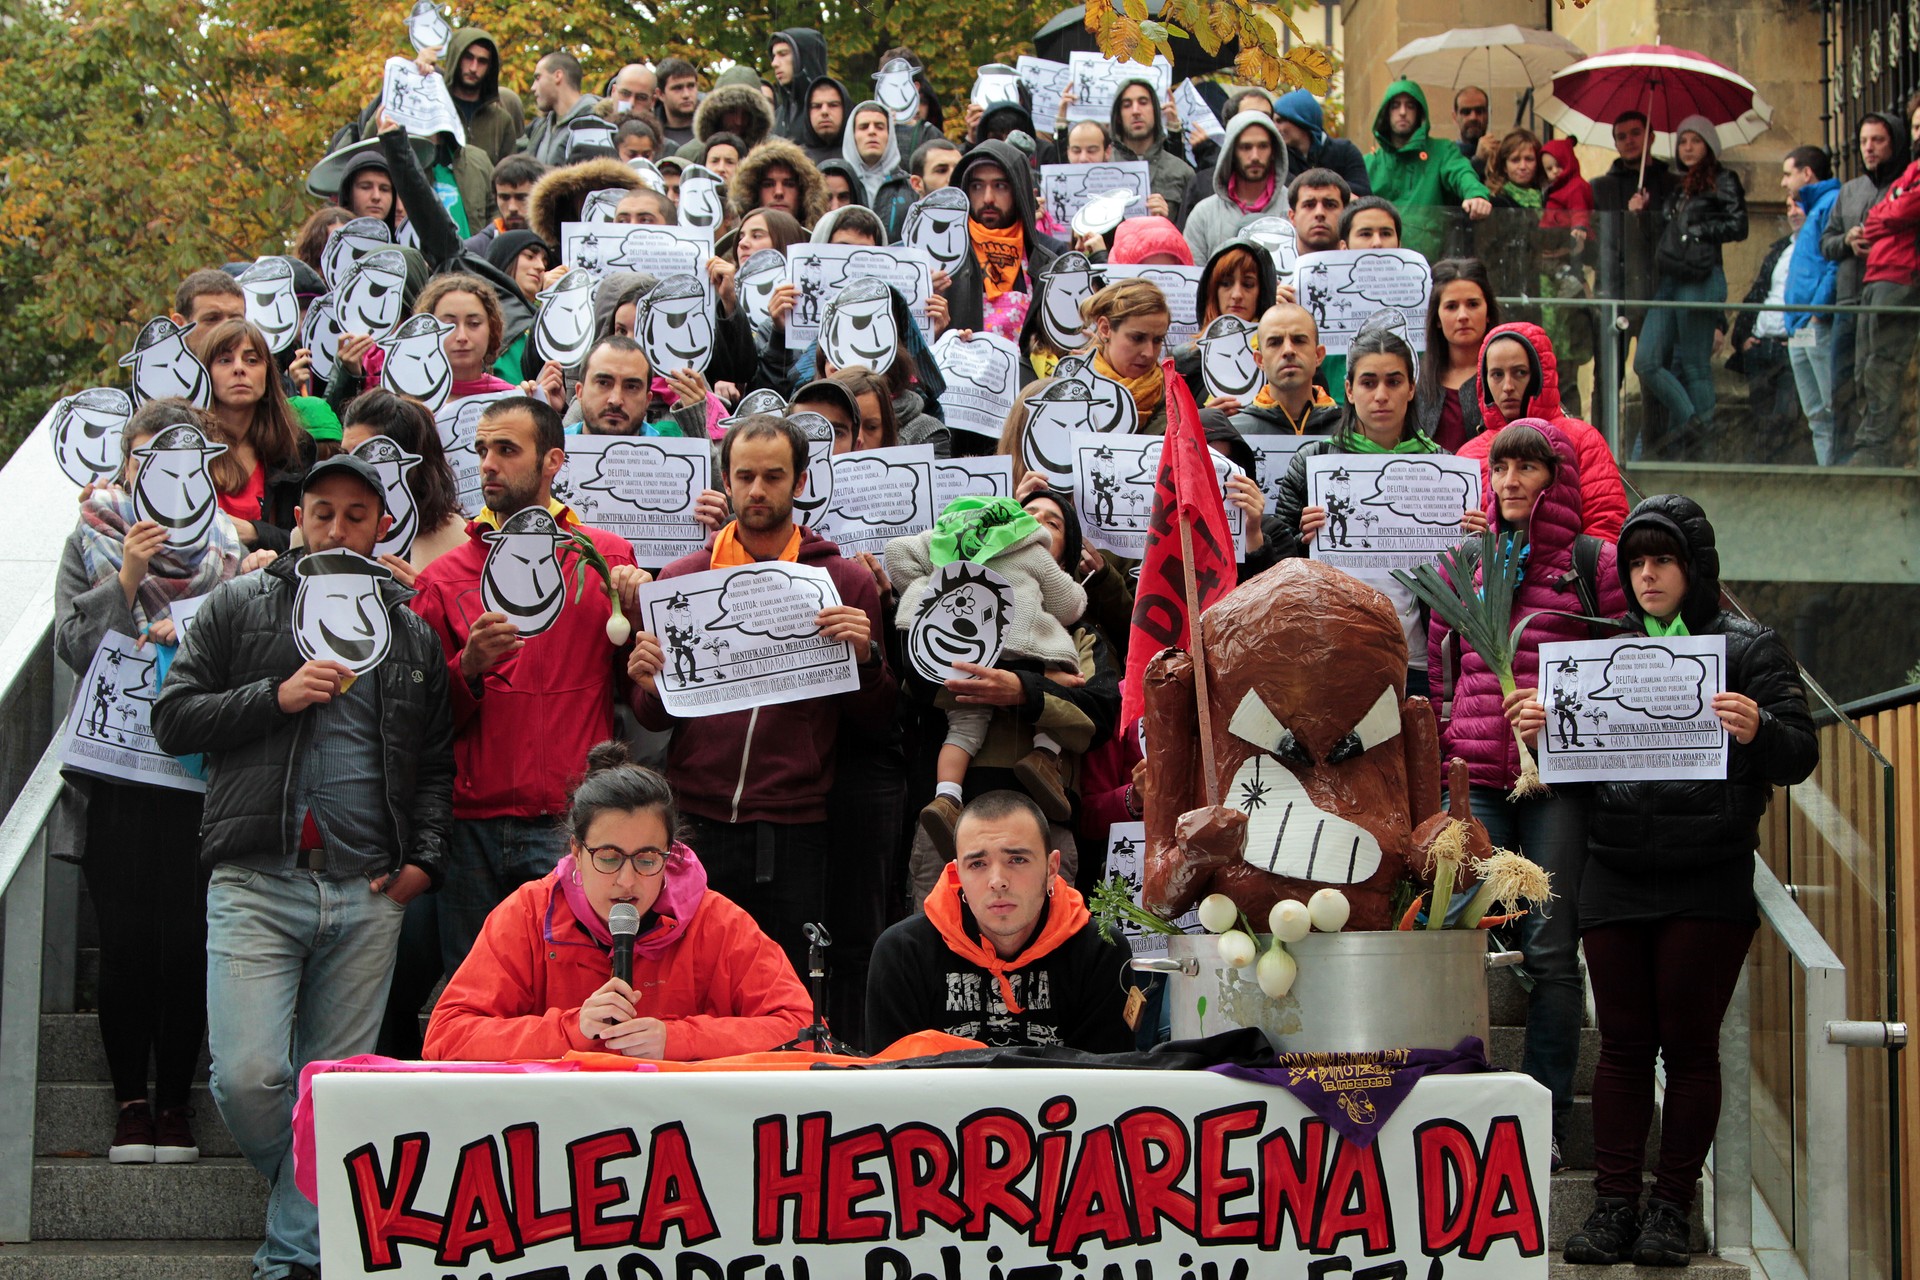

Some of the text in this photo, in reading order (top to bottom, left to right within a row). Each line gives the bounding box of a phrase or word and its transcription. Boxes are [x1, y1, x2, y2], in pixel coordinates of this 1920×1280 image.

[834, 487, 855, 497] DELITUA:
[597, 513, 636, 521] IDENTIFIKAZIO
[648, 514, 680, 523] MEHATXUEN
[620, 525, 700, 537] INDABADA HERRIKOIA!
[830, 525, 928, 543] IDENTIFIKAZIO ETA MEHATXUEN AURKA
[1427, 527, 1458, 535] MEHATXUEN
[1378, 538, 1434, 548] GORA INDABADA
[750, 587, 765, 595] TOPATU
[732, 601, 758, 612] DELITUA:
[760, 598, 782, 607] ELKARLANA
[773, 606, 788, 614] ESPAZIO
[790, 602, 810, 610] PUBLIKOA
[774, 625, 796, 633] ERLAZIOAK
[730, 638, 820, 662] IDENTIFIKAZIO ETA MEHATXUEN
[732, 646, 844, 677] GORA INDABADA HERRIKOIA!
[797, 668, 834, 681] AZAROAREN
[834, 665, 850, 675] 12AN
[1616, 676, 1638, 684] DELITUA:
[1609, 721, 1717, 732] IDENTIFIKAZIO ETA MEHATXUEN AURKA
[1610, 732, 1718, 747] GORA INDABADA HERRIKOIA!
[343, 1095, 1546, 1273] KALEA HERRIARENA DA
